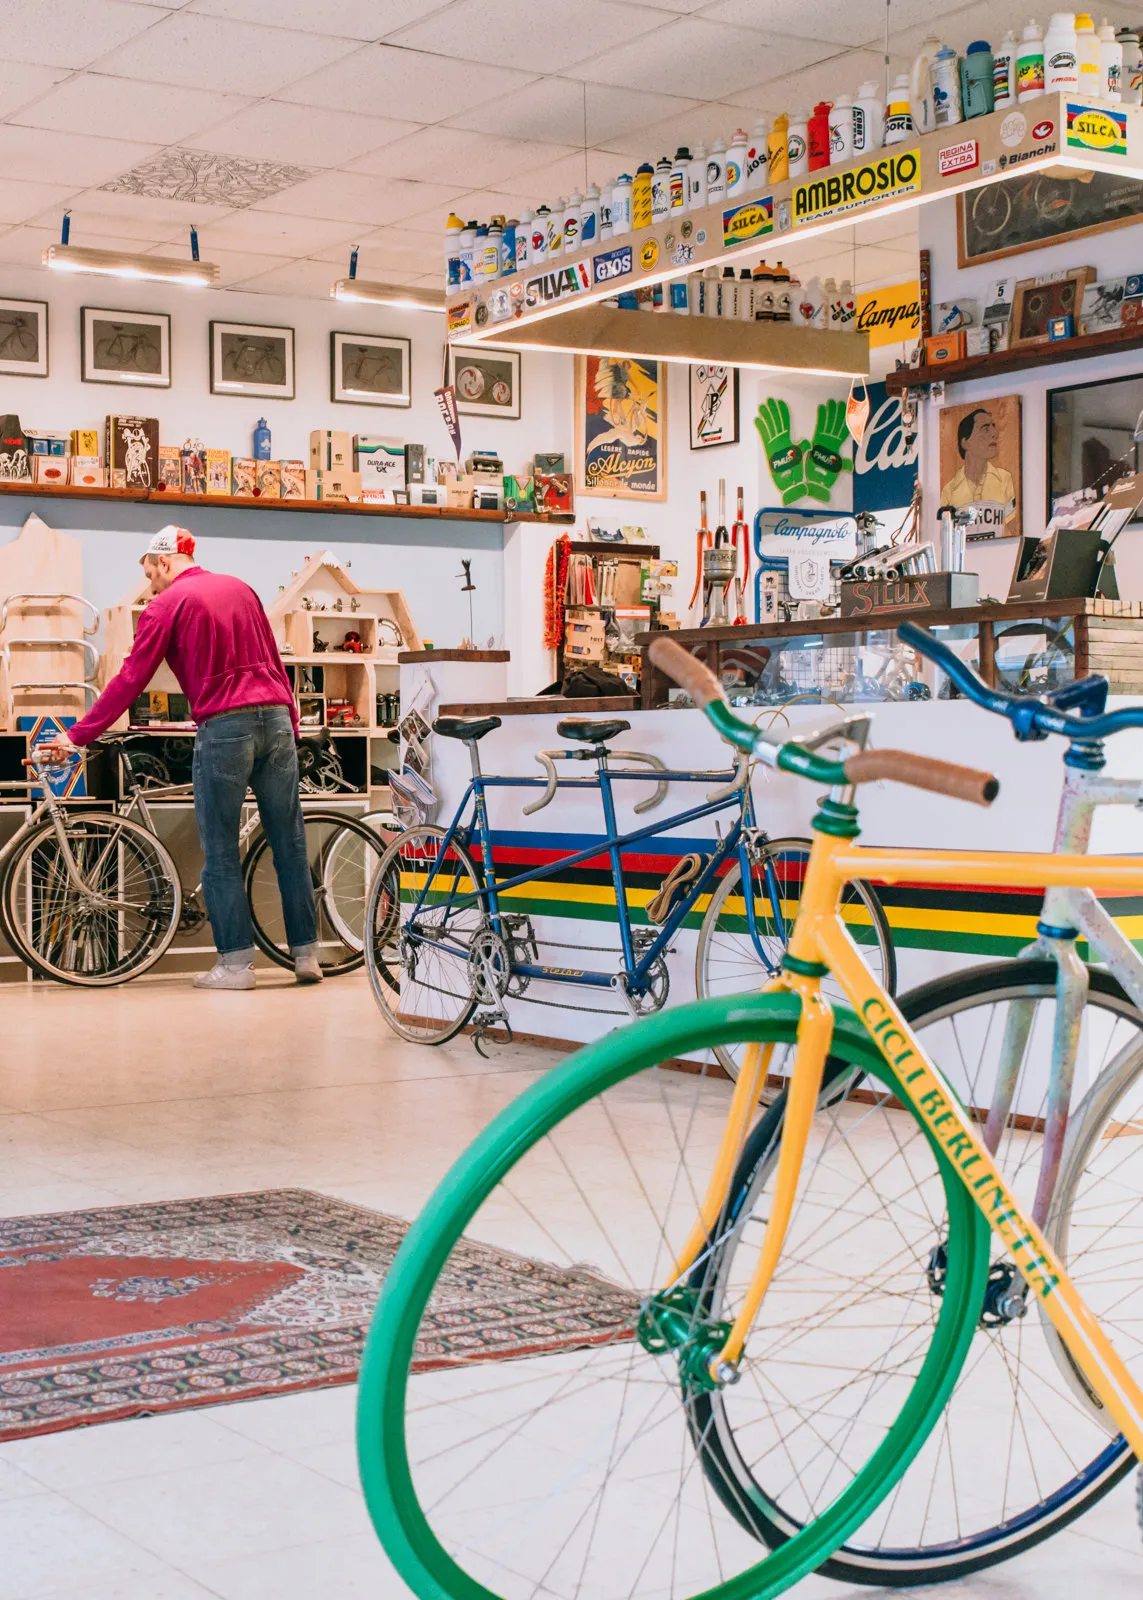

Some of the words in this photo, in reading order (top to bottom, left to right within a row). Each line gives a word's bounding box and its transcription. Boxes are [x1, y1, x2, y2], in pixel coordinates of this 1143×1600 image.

[1077, 121, 1118, 139] SILCA
[940, 143, 973, 160] REGINA
[941, 154, 974, 170] EXTRA
[1009, 143, 1056, 164] Bianchi
[795, 154, 917, 216] AMBROSIO
[799, 210, 834, 223] TEAM
[837, 185, 915, 211] SUPPORTER
[731, 212, 765, 232] SILCA
[597, 253, 632, 281] GIOS
[627, 448, 650, 457] RAPIDE
[367, 460, 396, 468] DURA-ACE
[588, 453, 656, 478] Alcyon
[631, 481, 656, 490] monde
[766, 518, 850, 545] Campagnolo
[850, 581, 931, 617] SILUX
[861, 998, 926, 1084] CICLI
[919, 1088, 1060, 1298] BERLINETTA
